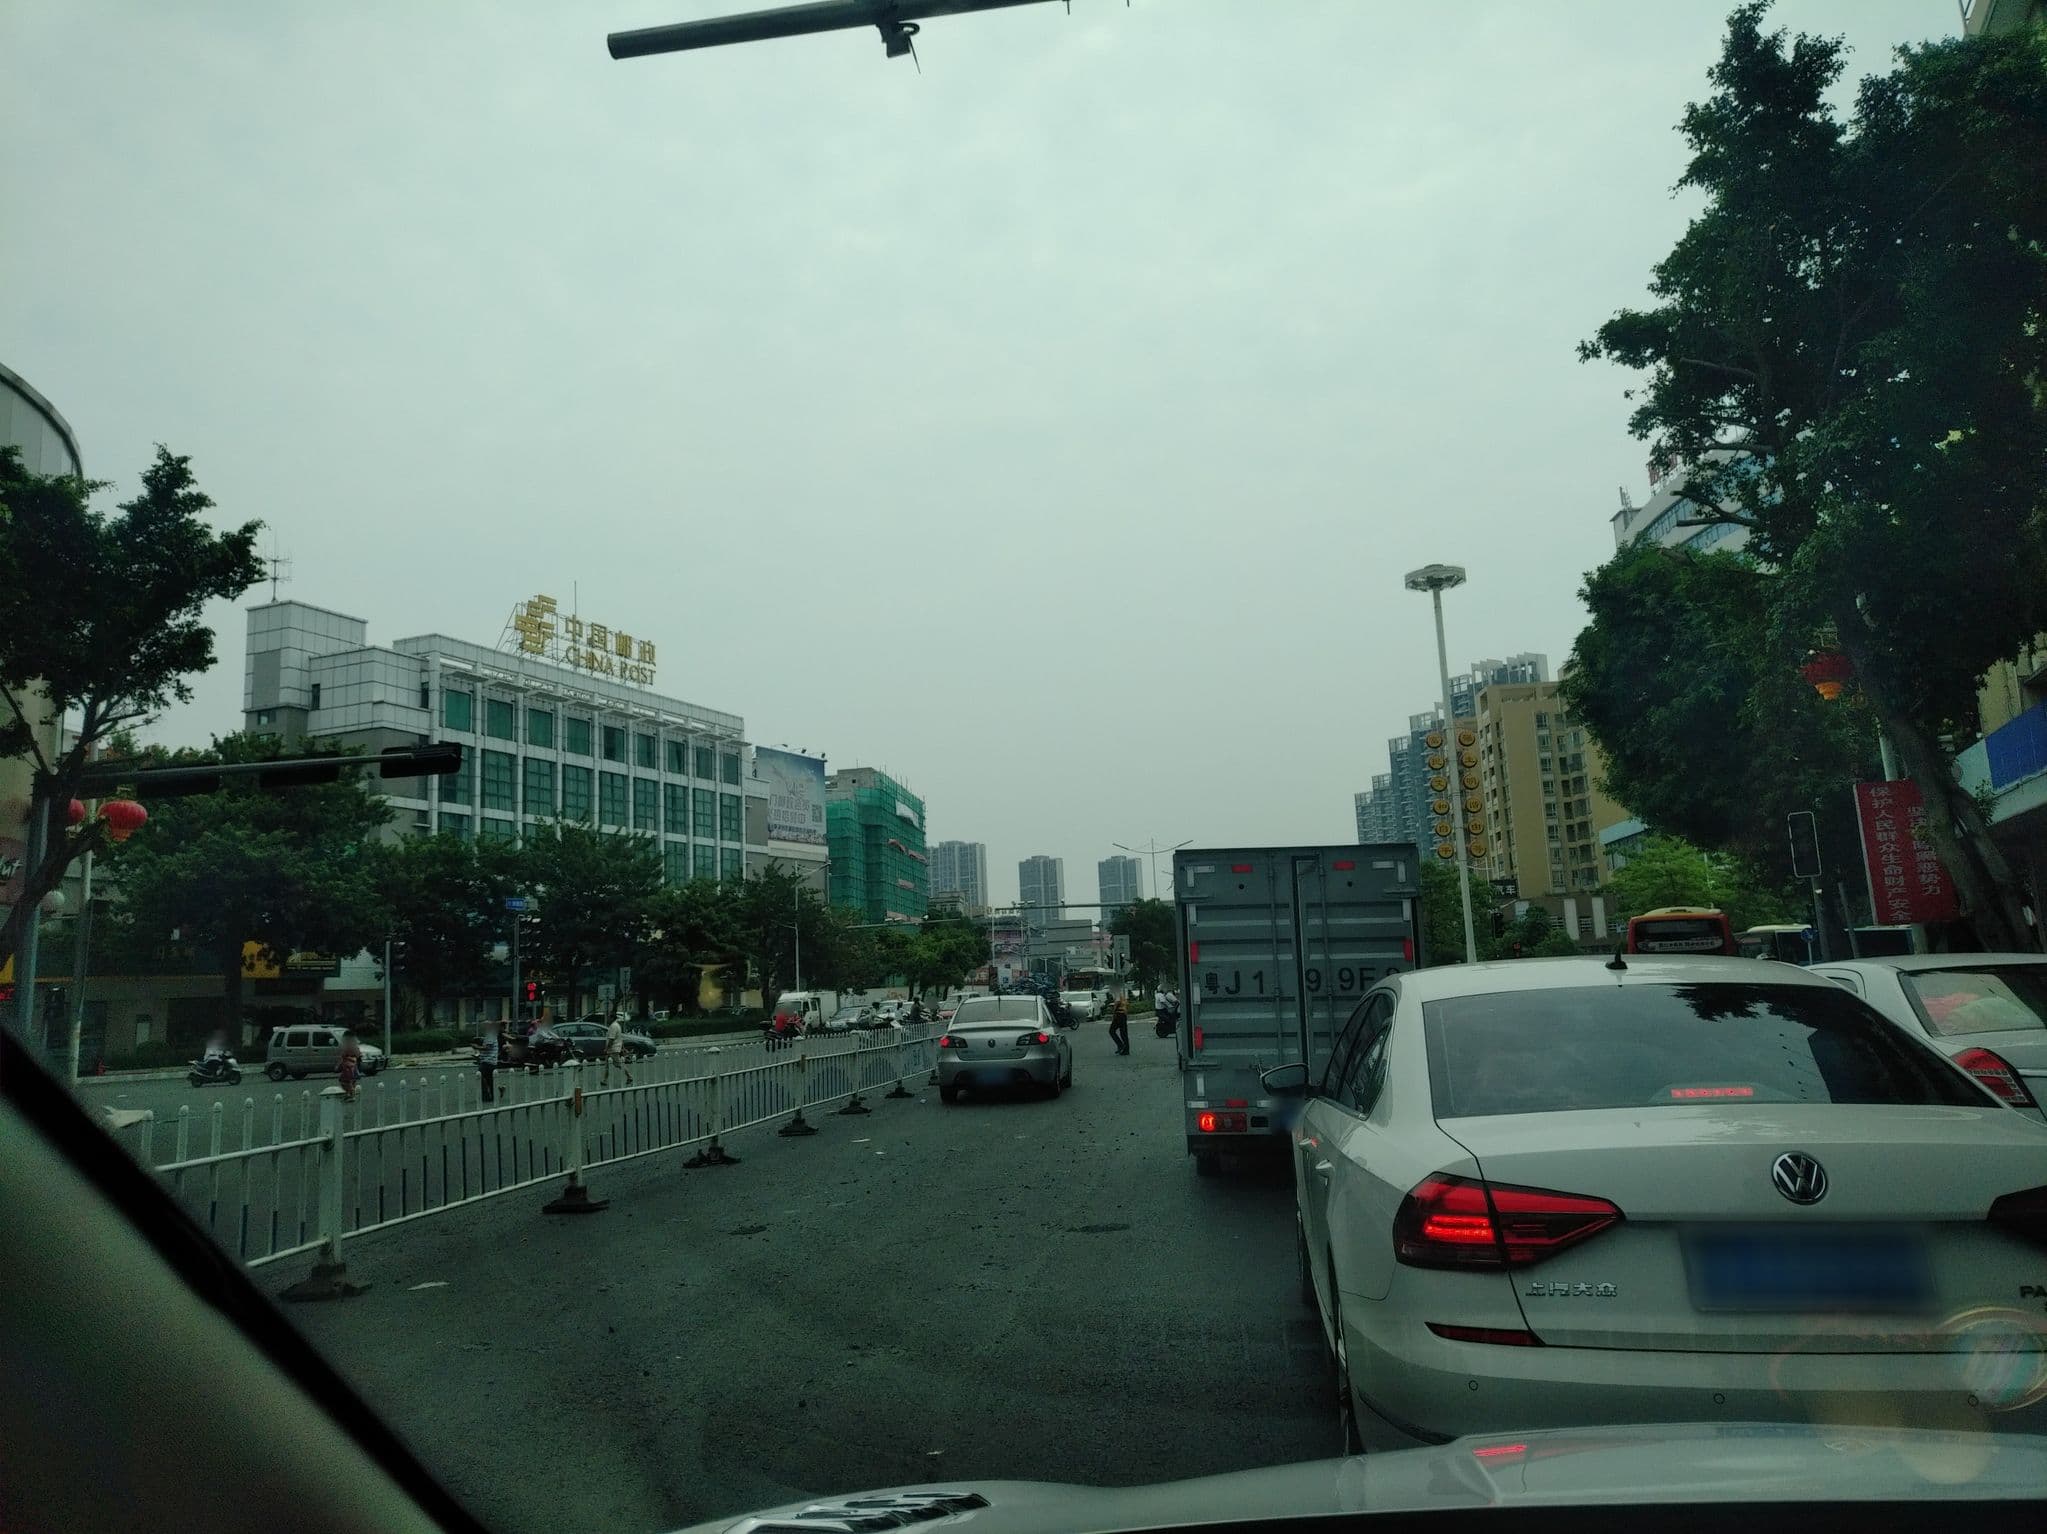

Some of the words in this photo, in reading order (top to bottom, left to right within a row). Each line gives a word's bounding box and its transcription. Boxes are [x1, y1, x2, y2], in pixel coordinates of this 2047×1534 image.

[566, 614, 656, 667] 中国邮政
[566, 645, 614, 676] CHINA
[620, 660, 656, 685] POST
[1525, 1281, 1618, 1297] 上汽大众
